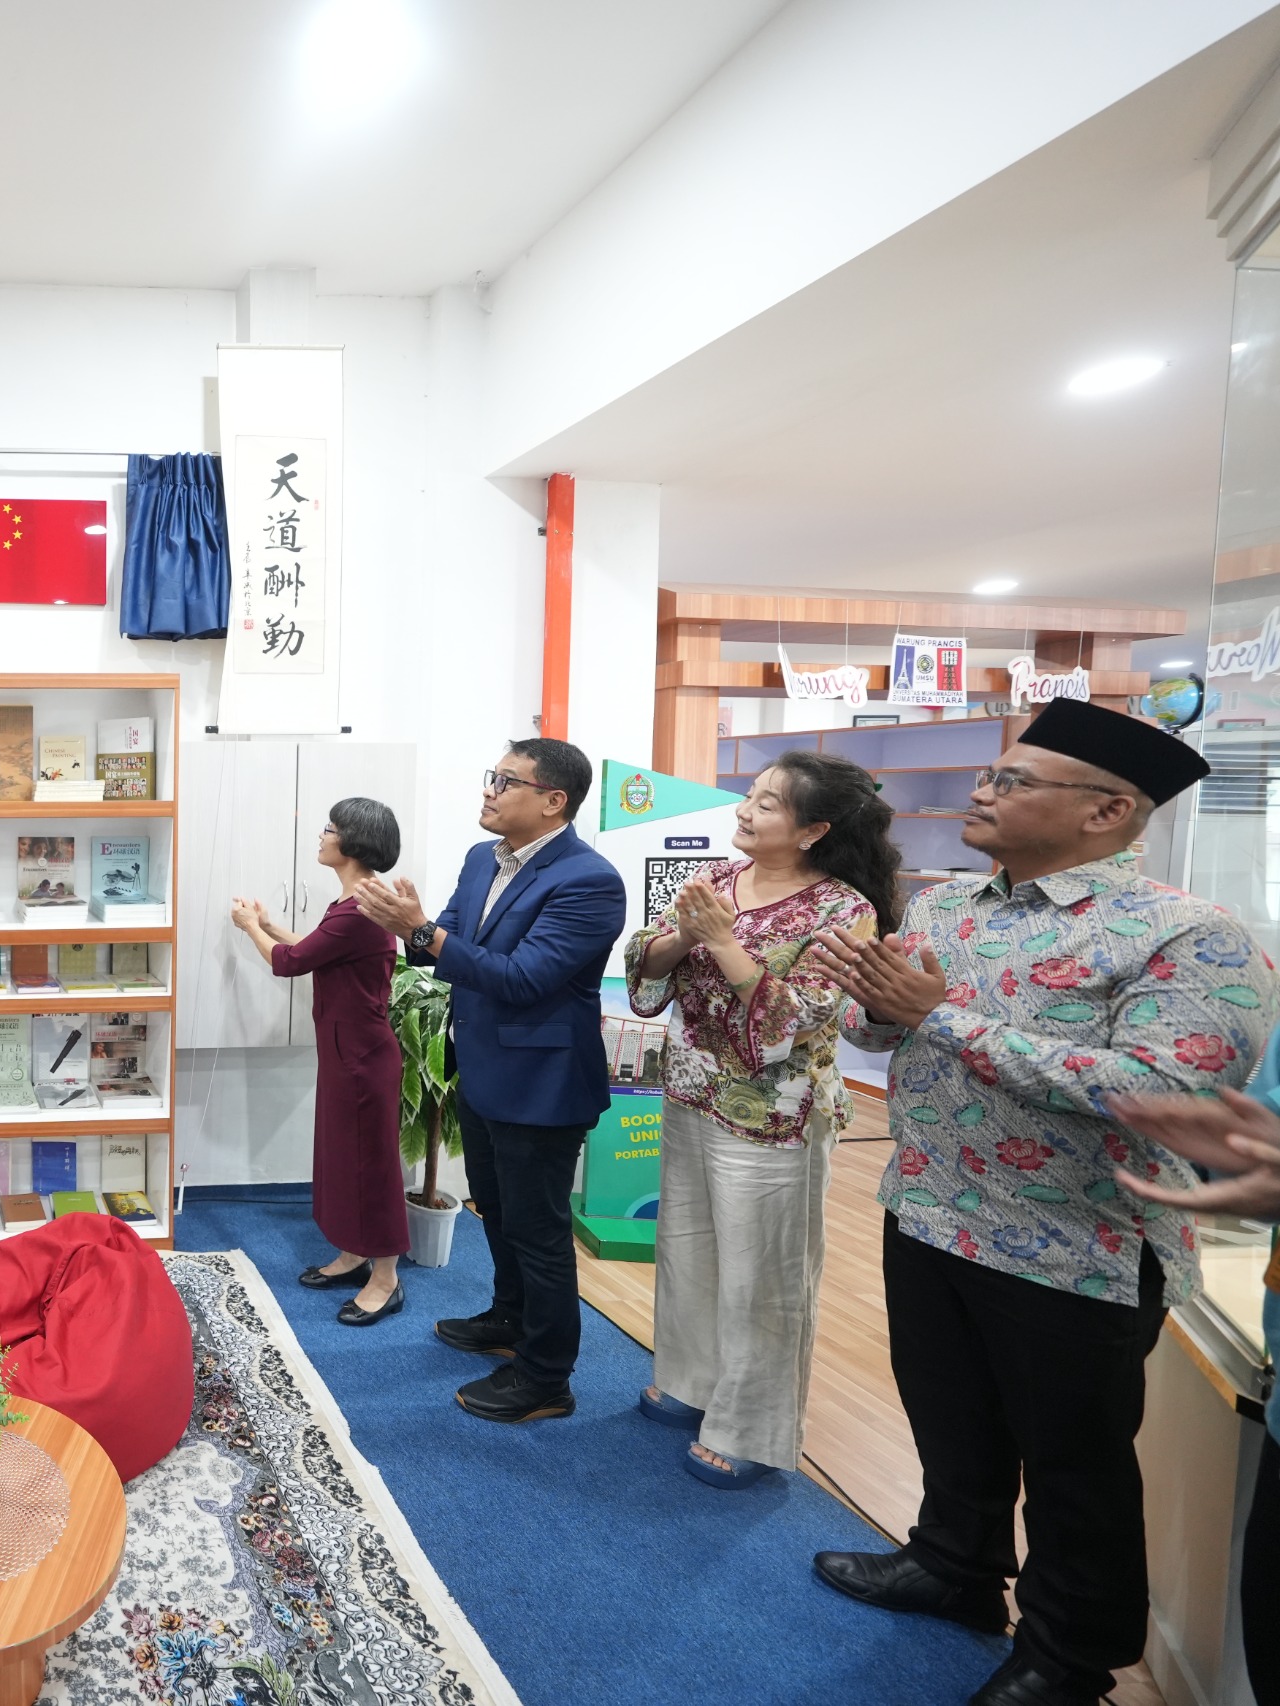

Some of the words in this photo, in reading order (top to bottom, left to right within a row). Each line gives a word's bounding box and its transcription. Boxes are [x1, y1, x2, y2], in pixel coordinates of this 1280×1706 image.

[262, 452, 310, 659] 天道酬勤
[896, 638, 926, 646] WARUNG
[927, 640, 963, 648] PRANCIS
[1012, 660, 1088, 700] Prancis
[892, 695, 932, 703] SUMATERA
[630, 1129, 662, 1143] UNI
